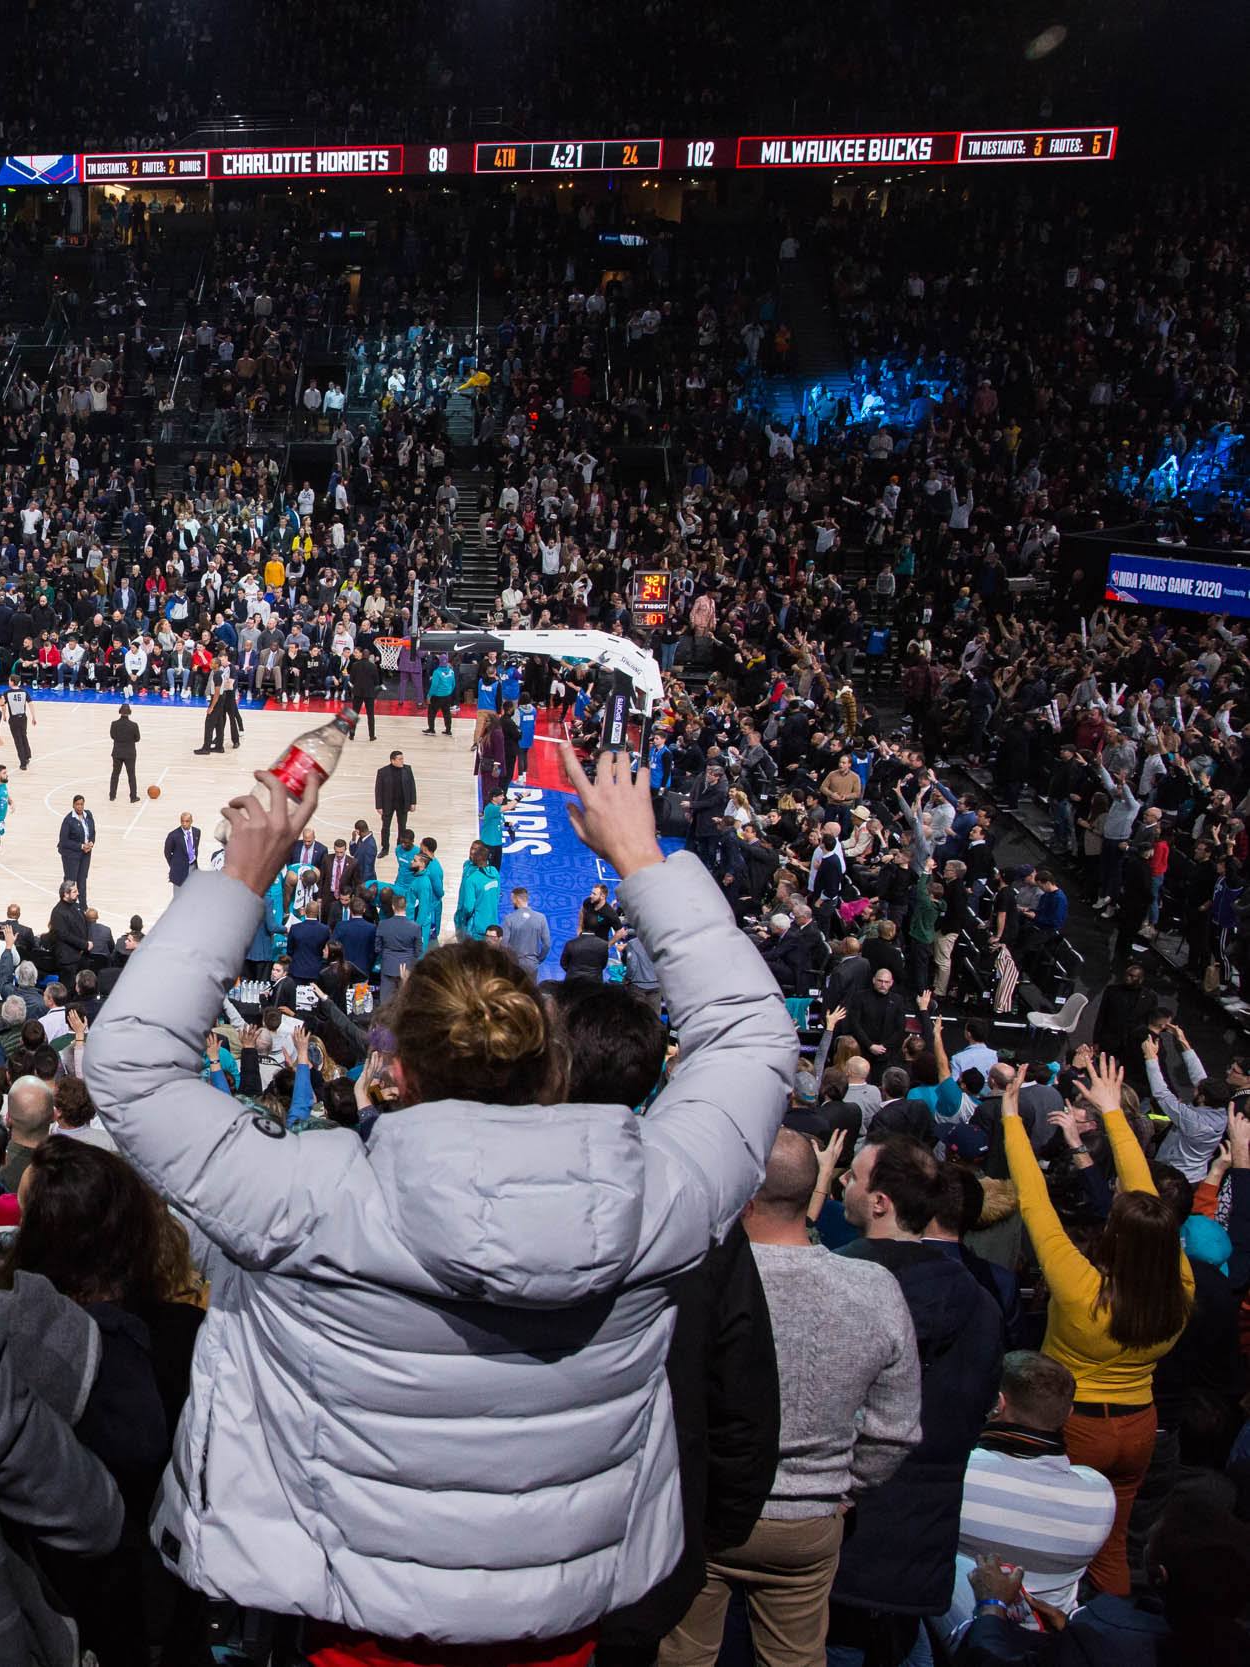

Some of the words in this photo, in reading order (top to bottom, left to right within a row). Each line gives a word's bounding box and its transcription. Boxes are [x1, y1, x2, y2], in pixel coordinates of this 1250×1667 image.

[687, 142, 715, 167] 102
[761, 139, 866, 163] MILWAUKEE
[868, 138, 933, 161] BUCKS
[981, 140, 1026, 155] RESTANTS:
[1034, 137, 1044, 156] 3
[1049, 138, 1083, 153] FAUTES:
[1092, 135, 1102, 154] 5
[222, 152, 311, 174] CHARLOTTE
[316, 150, 389, 173] HORNETS
[429, 148, 447, 172] 89
[494, 148, 516, 167] 4TH
[550, 144, 583, 168] 4:21
[622, 145, 638, 166] 24
[132, 160, 138, 175] 2
[142, 161, 165, 173] FAUTES:
[169, 159, 175, 174] 2
[179, 161, 201, 173] BONUS
[643, 585, 661, 599] 24
[1118, 571, 1138, 588] NBA
[1139, 573, 1168, 592] PARIS
[1167, 576, 1195, 596] GAME
[1194, 580, 1223, 599] 2020
[615, 697, 624, 721] SPORTS
